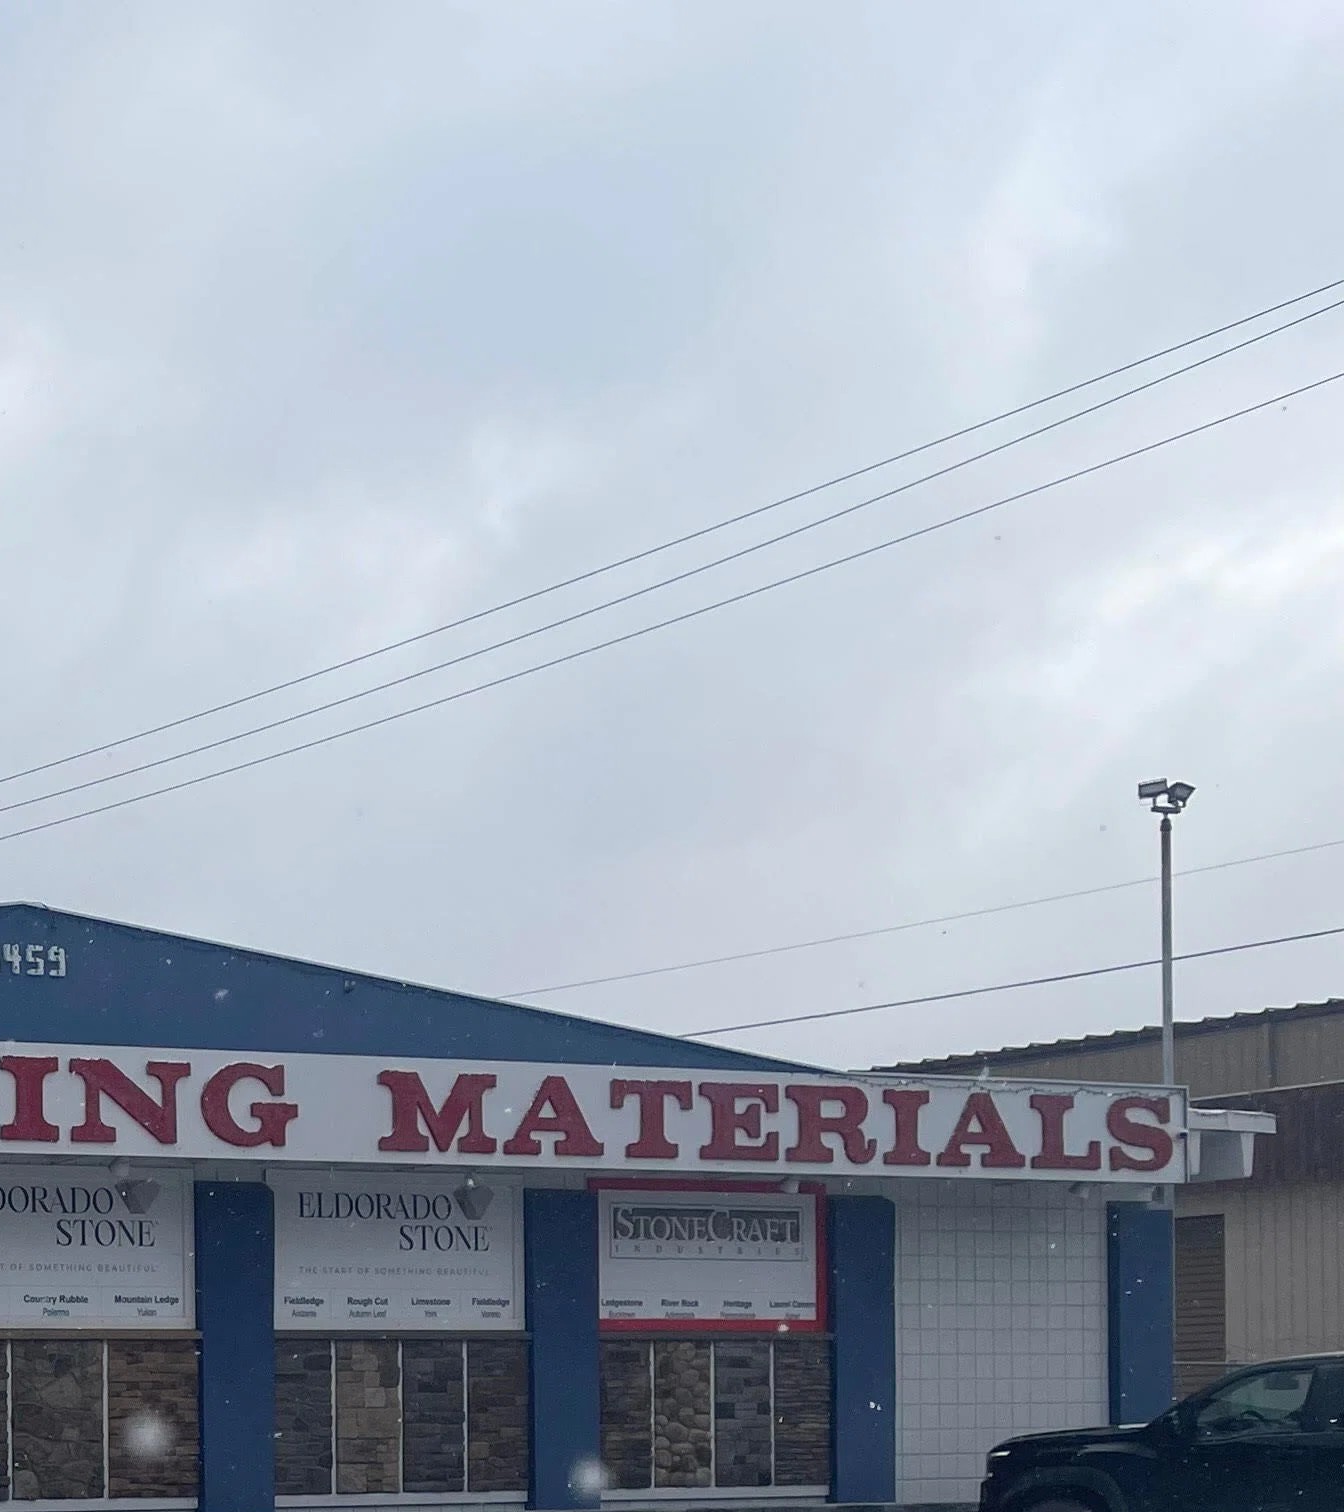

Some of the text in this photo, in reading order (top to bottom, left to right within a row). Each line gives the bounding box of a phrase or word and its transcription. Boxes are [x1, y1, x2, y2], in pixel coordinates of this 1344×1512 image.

[377, 1069, 1175, 1171] MATERIALS
[298, 1191, 453, 1221] ELDORADO
[55, 1218, 156, 1248] STONE
[399, 1224, 490, 1252] STONE
[114, 1295, 180, 1306] Mountain Ledge
